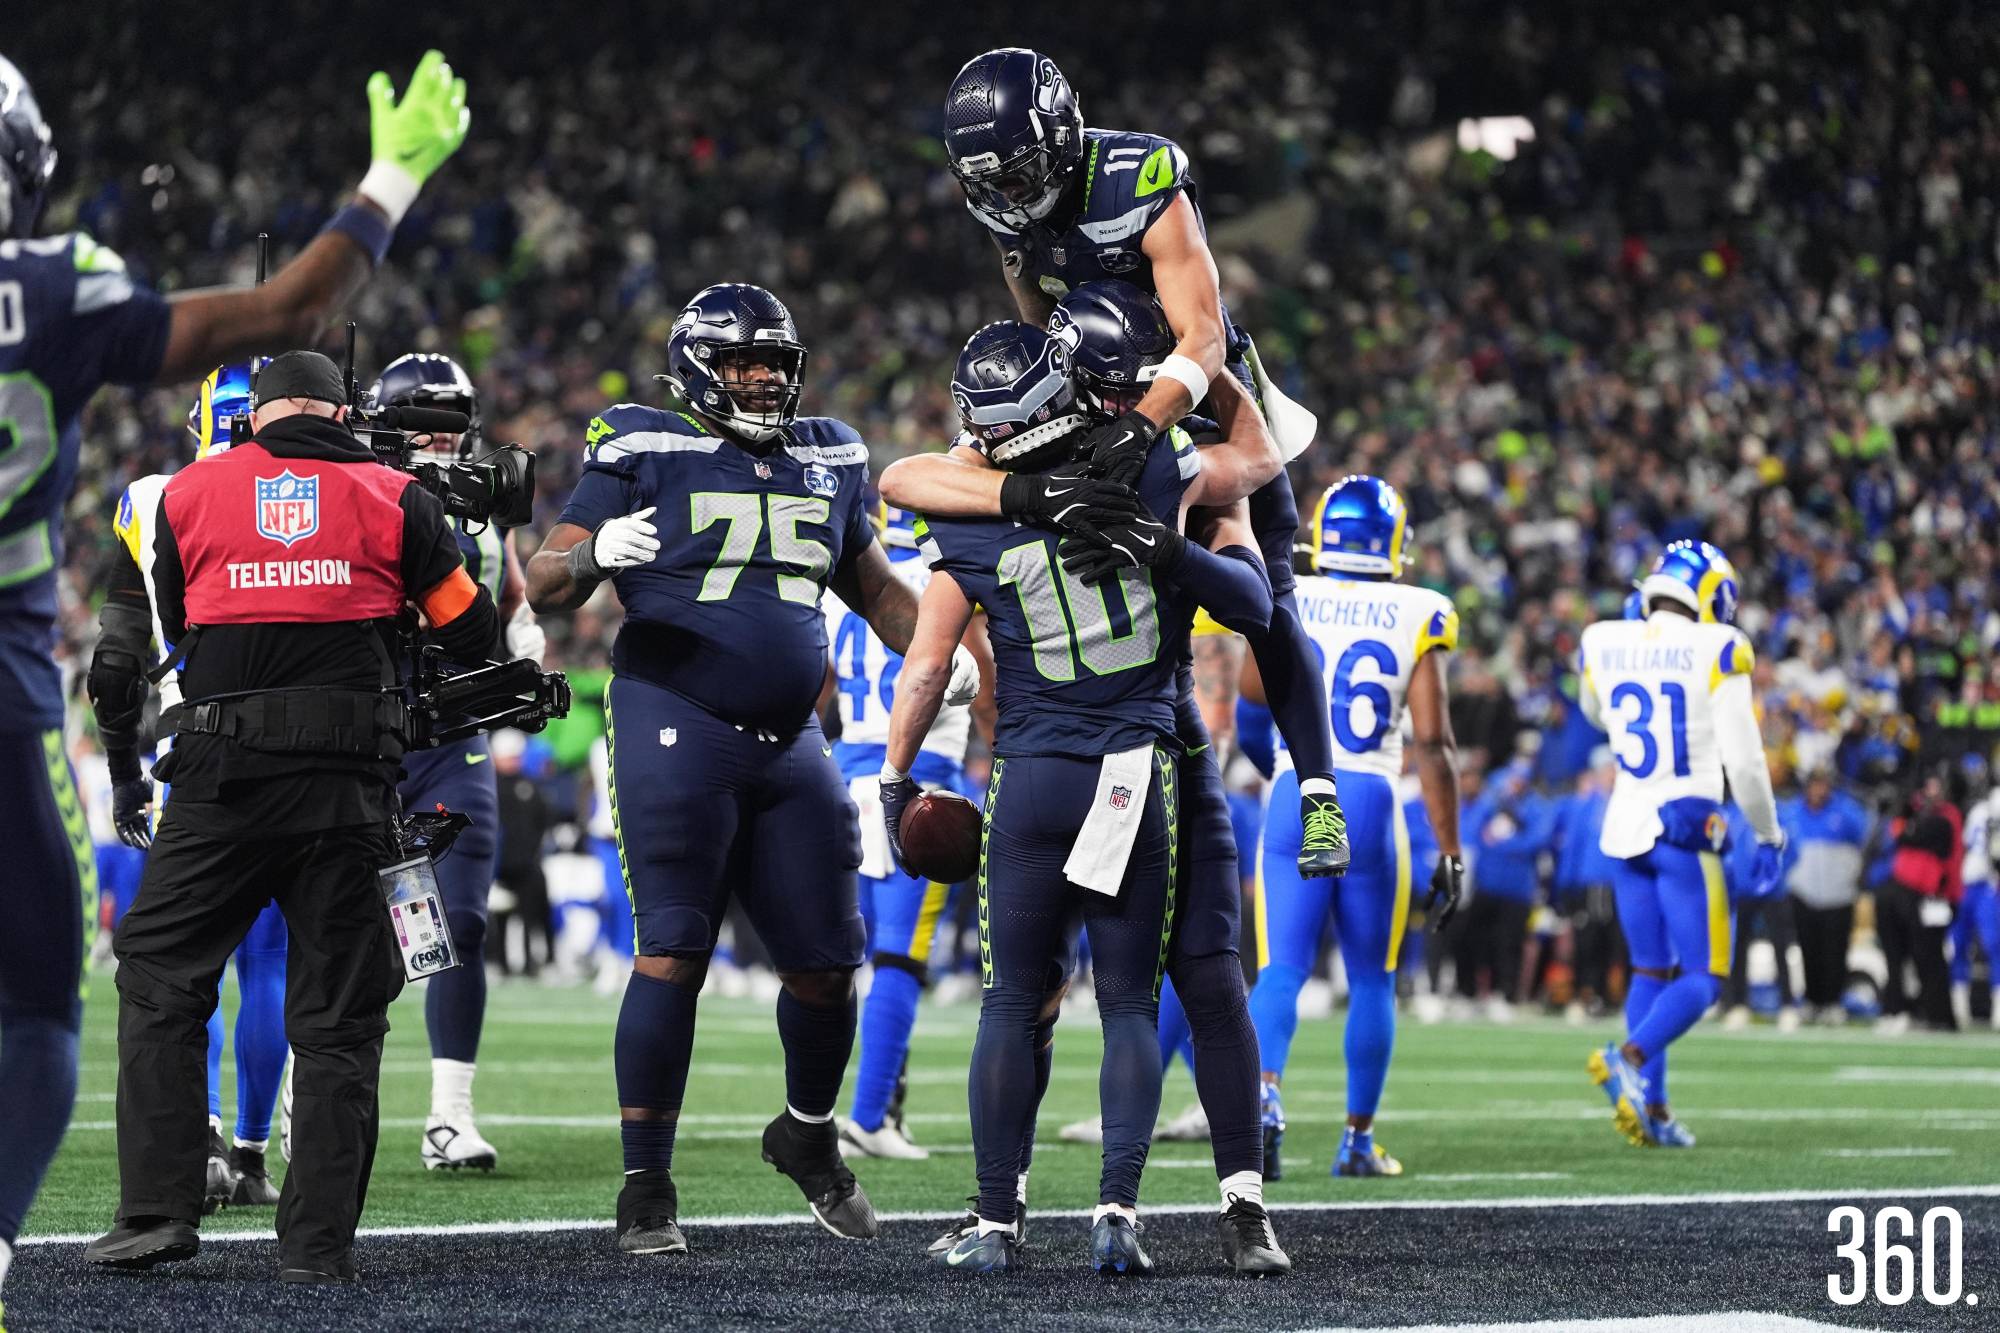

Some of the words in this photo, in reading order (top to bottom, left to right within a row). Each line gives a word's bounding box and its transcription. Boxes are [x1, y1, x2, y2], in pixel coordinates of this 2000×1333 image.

[1104, 148, 1148, 175] 11
[1008, 421, 1061, 448] SEATTLE
[263, 501, 312, 535] NFL
[690, 492, 831, 607] 75
[227, 559, 352, 589] TELEVISION
[997, 534, 1161, 682] 10
[1601, 647, 1695, 672] WILLIAMS
[1309, 636, 1399, 754] 6
[516, 709, 540, 723] PRO
[1611, 681, 1691, 779] 31
[418, 949, 443, 964] FOX
